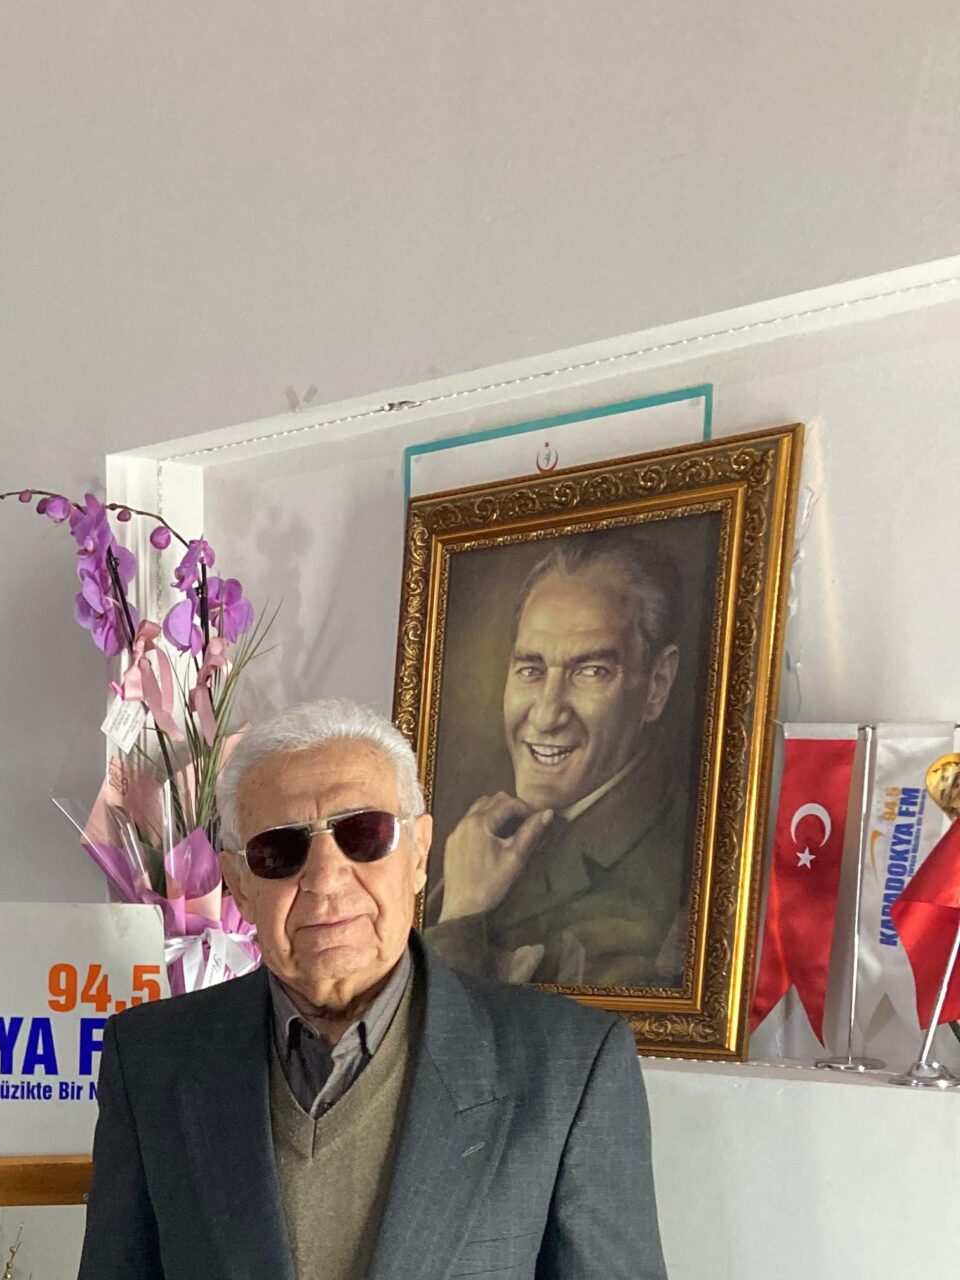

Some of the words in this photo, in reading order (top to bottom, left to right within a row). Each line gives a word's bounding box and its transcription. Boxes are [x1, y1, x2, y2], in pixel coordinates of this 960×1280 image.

[897, 787, 920, 817] FM
[47, 963, 161, 1013] 94.5
[79, 1018, 107, 1076] F
[59, 1081, 84, 1101] Bir
